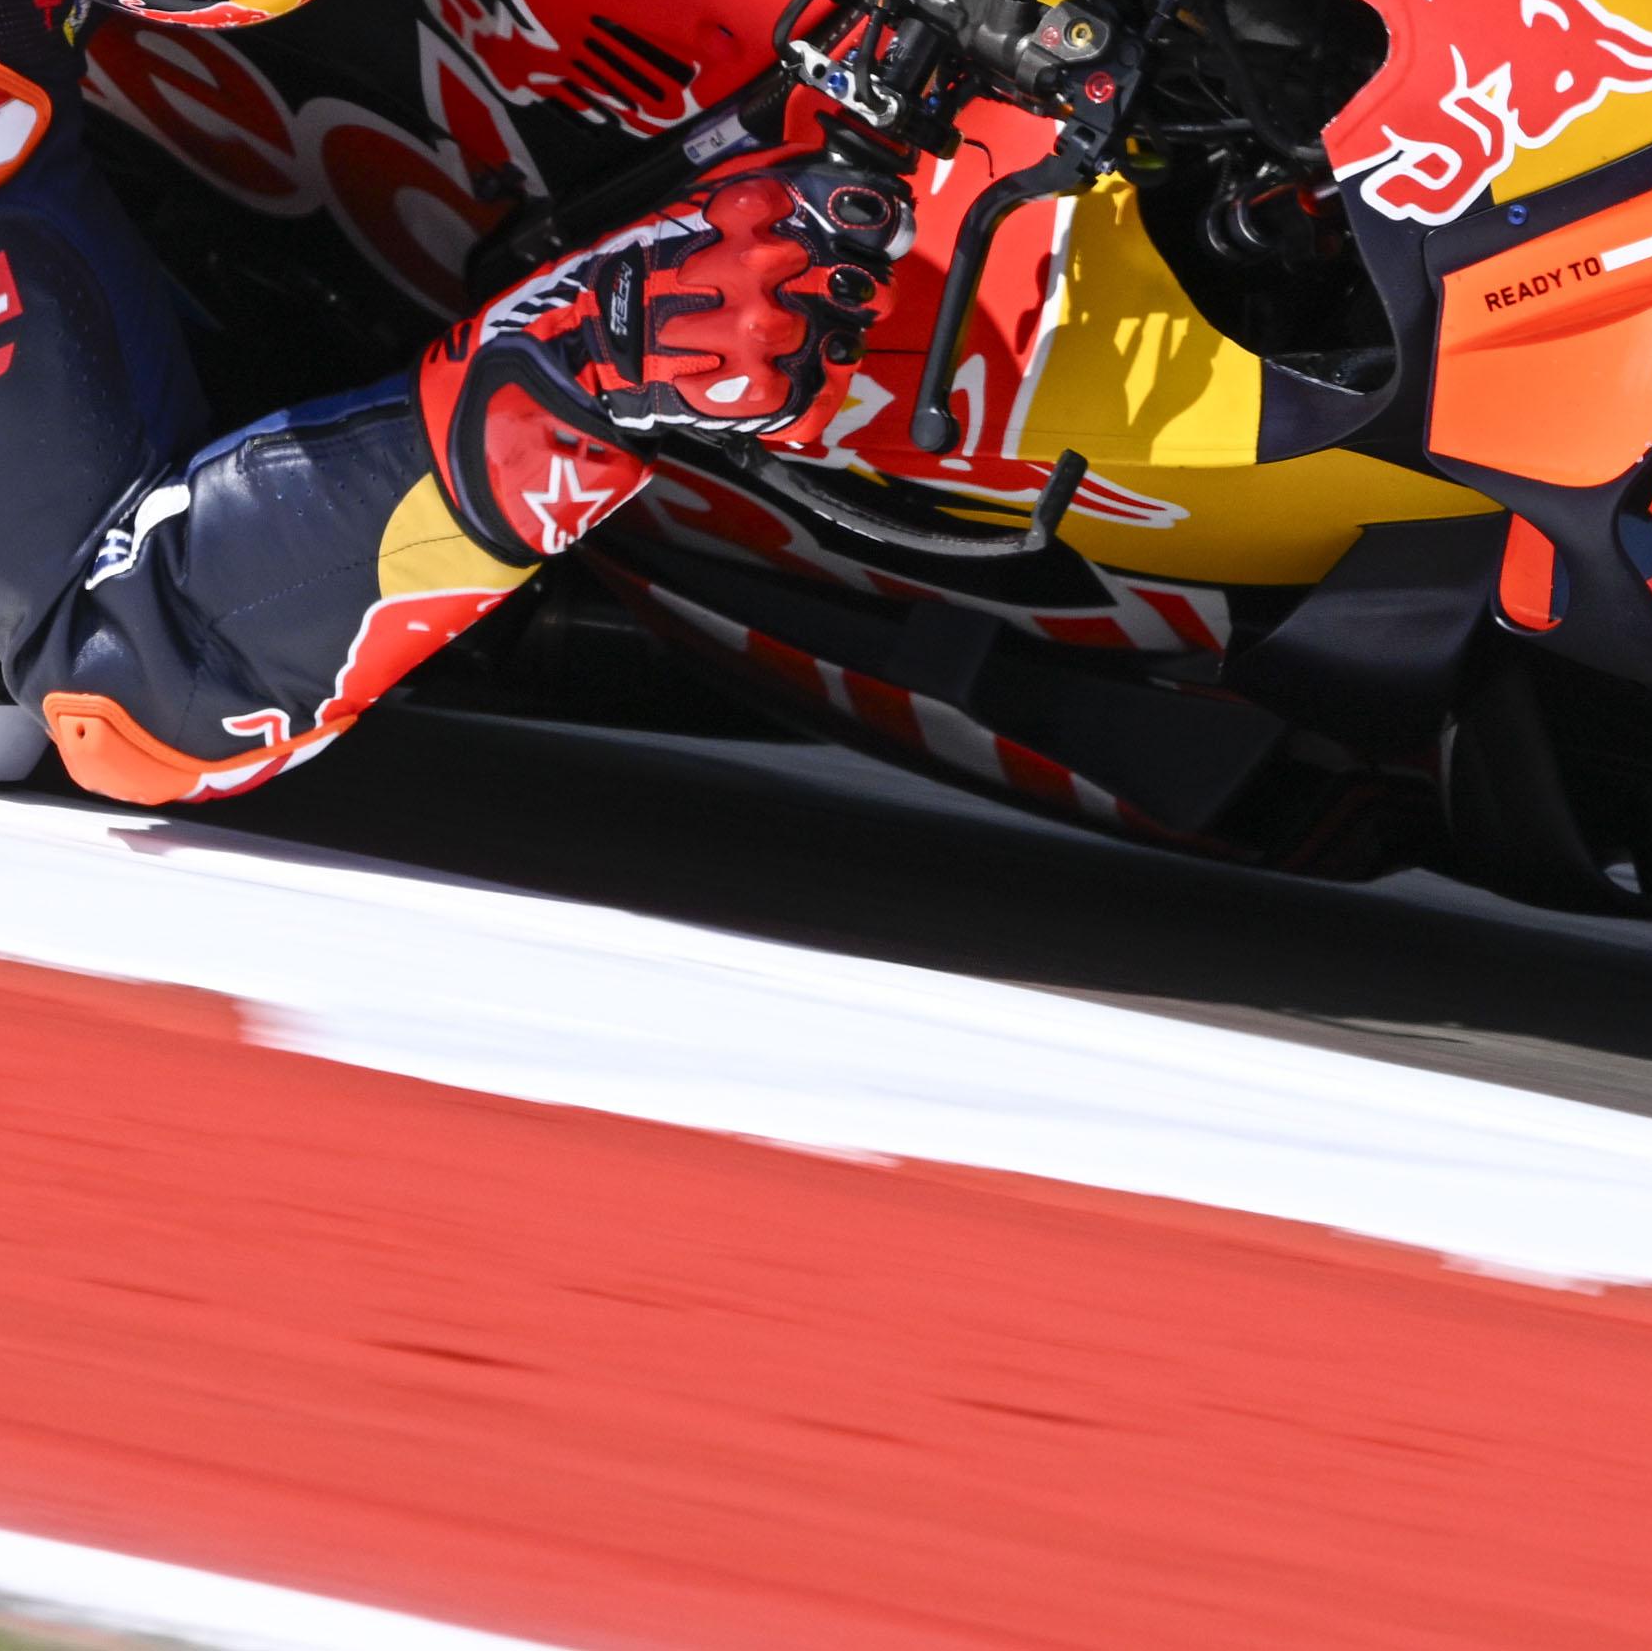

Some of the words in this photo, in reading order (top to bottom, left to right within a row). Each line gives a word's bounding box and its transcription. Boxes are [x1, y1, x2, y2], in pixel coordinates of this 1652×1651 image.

[81, 8, 549, 333] ed
[1484, 269, 1563, 312] READY
[1568, 257, 1601, 281] TO
